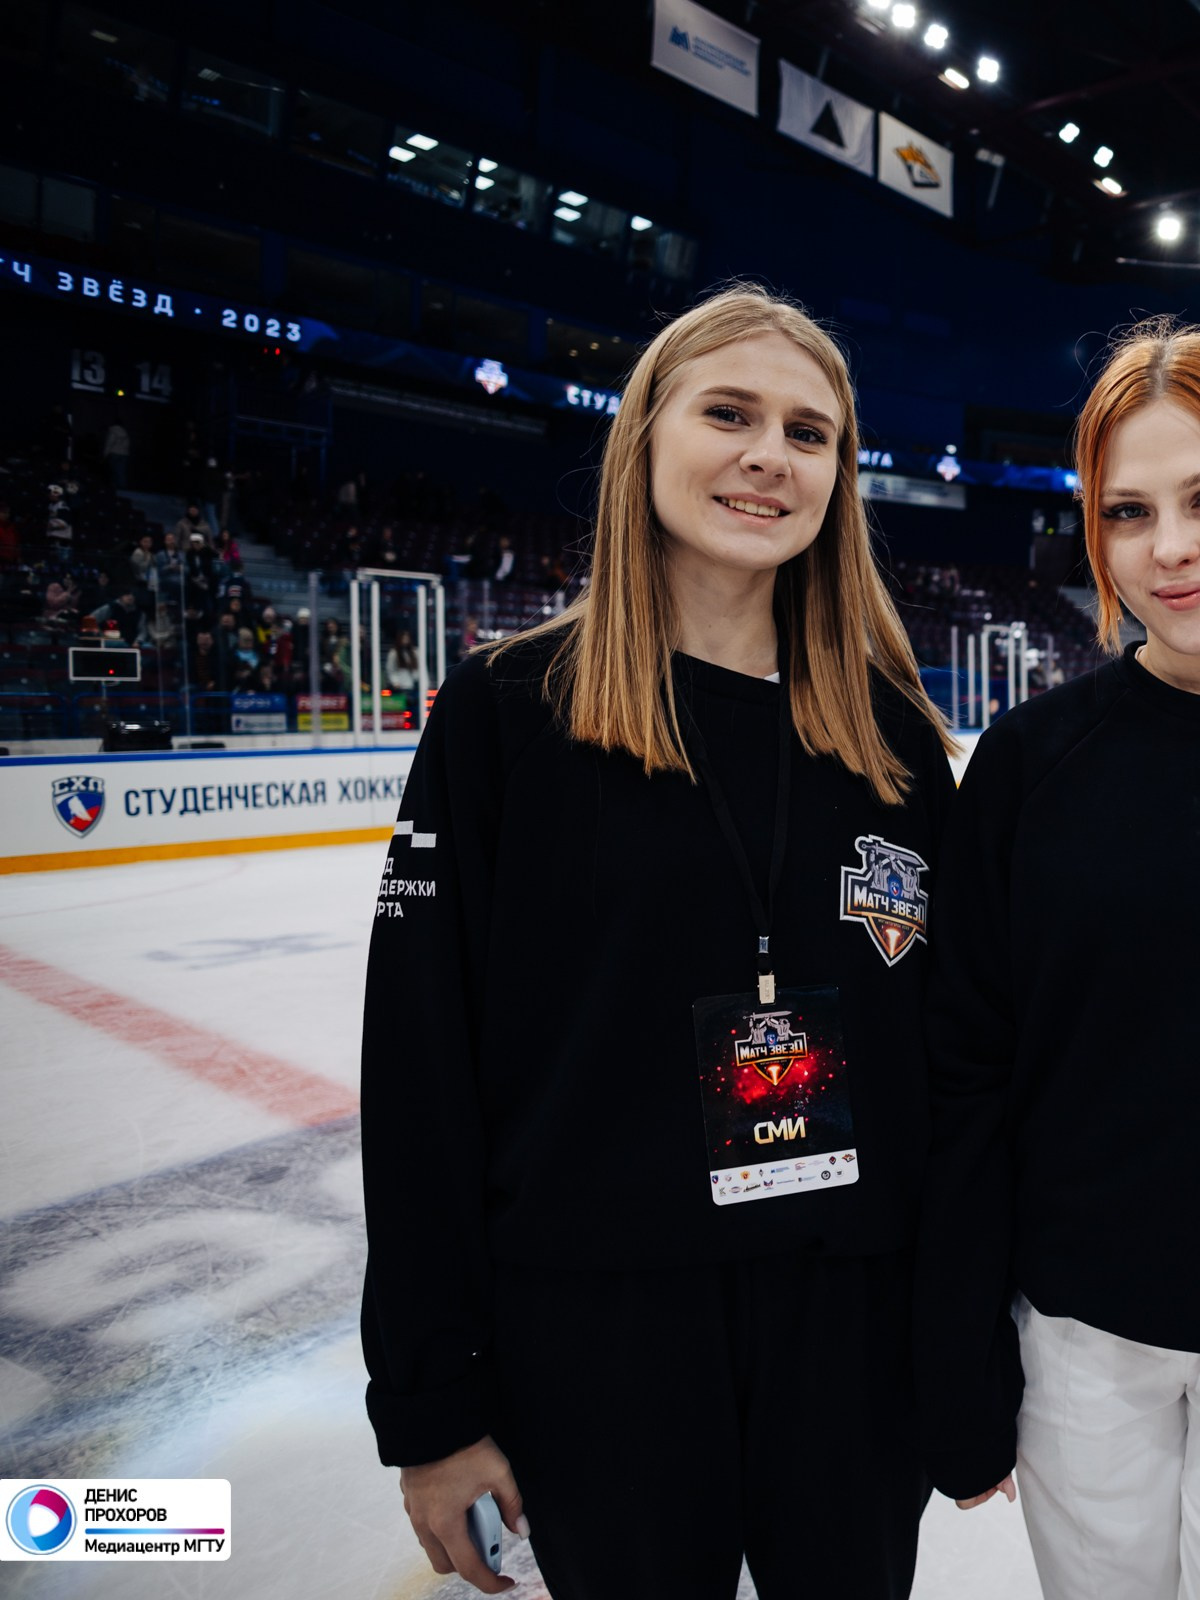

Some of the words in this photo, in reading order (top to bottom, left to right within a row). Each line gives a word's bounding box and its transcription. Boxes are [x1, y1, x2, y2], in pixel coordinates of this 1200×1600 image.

[57, 270, 175, 318] ЗВЁЗД
[221, 308, 302, 343] 2023
[70, 348, 108, 386] 13
[124, 778, 327, 817] СТУДЕНЧЕСКАЯ
[378, 879, 436, 897] ДЕРЖКИ
[377, 901, 404, 918] РТА
[754, 1116, 806, 1144] СМИ
